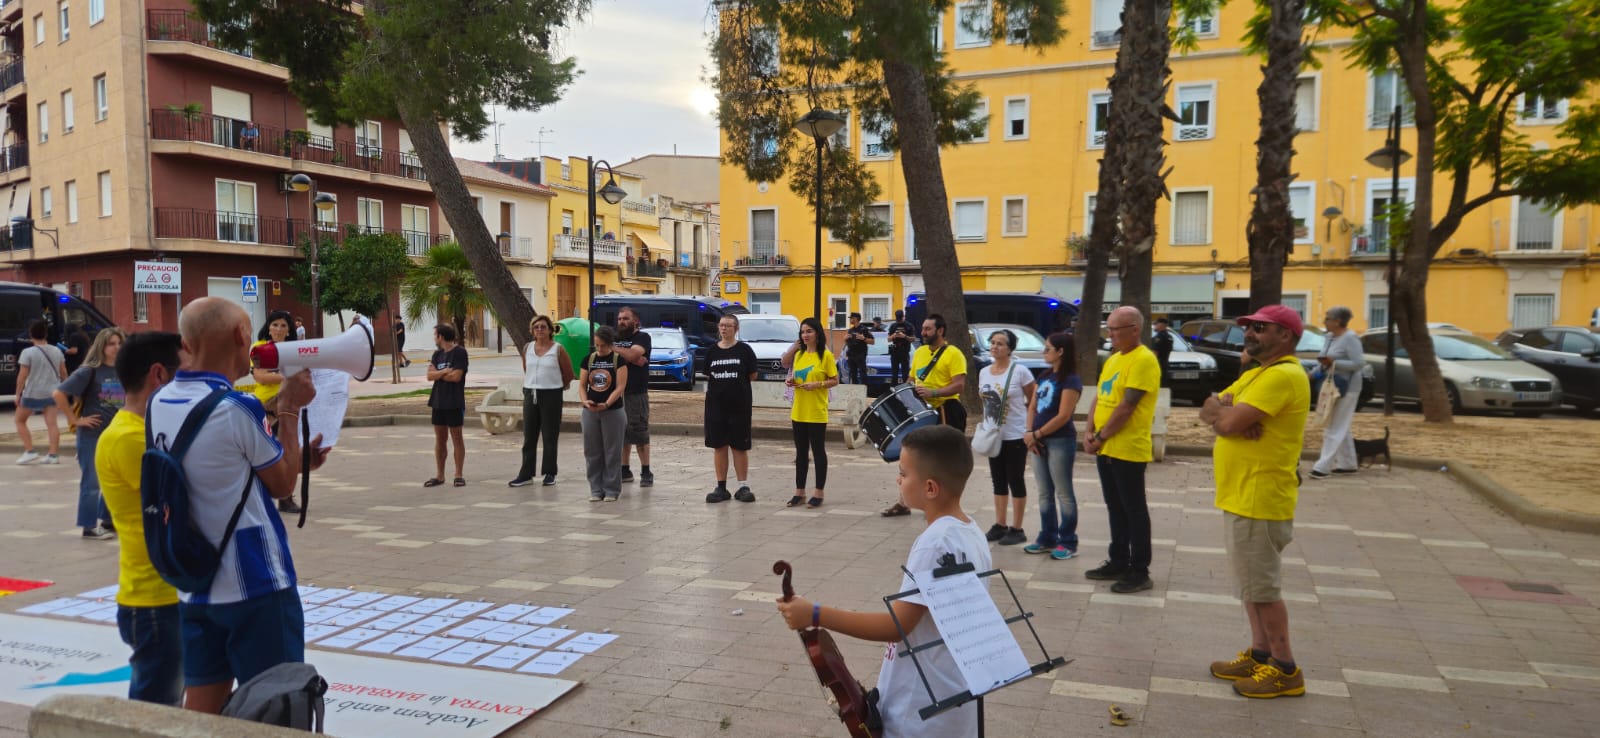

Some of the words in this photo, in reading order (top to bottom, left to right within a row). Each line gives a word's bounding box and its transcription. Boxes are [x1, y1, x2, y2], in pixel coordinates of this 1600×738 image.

[298, 346, 319, 354] PYLE
[330, 682, 428, 701] BARBARIE
[336, 700, 390, 713] amb
[429, 695, 448, 705] la
[449, 697, 537, 717] CONTRA
[393, 707, 488, 729] Acabem
